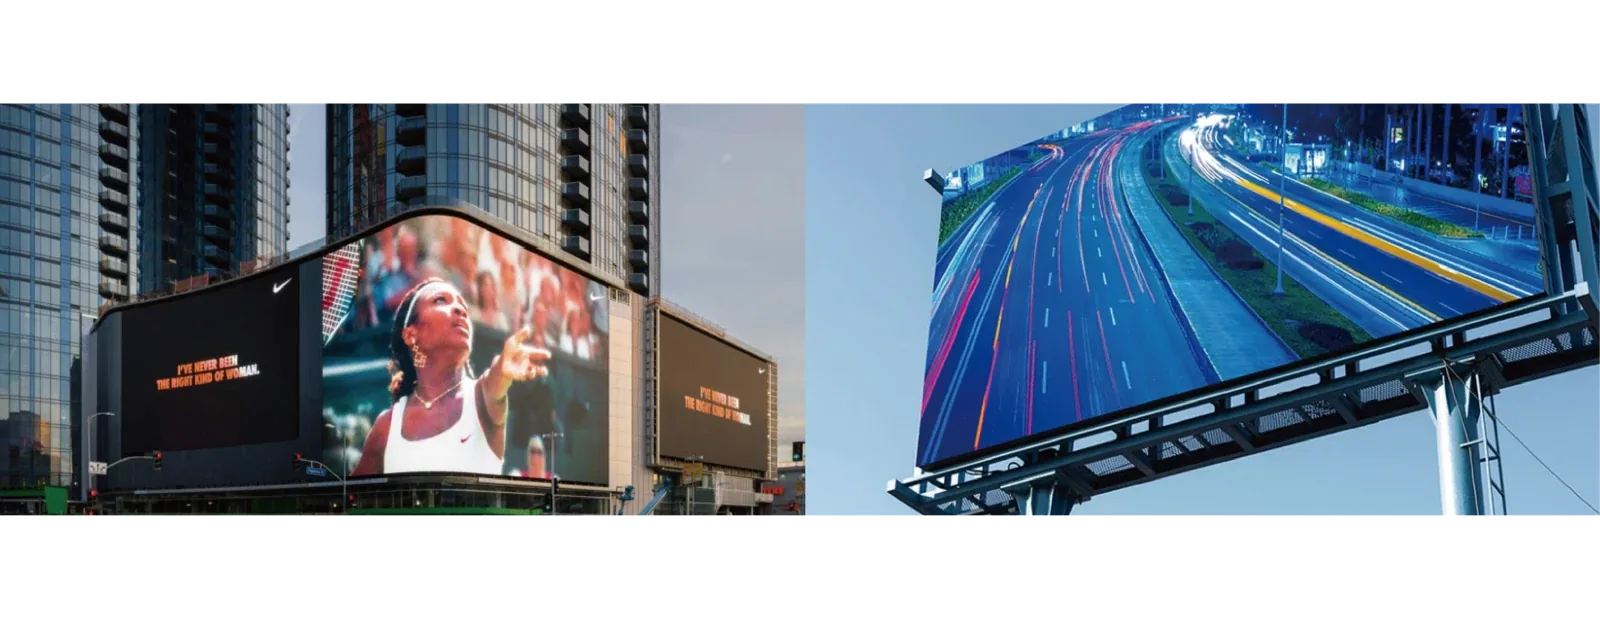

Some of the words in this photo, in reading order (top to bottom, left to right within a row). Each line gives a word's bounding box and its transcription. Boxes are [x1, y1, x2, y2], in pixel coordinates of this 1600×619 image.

[177, 364, 193, 375] I'VE
[194, 359, 218, 373] NEVER
[219, 354, 238, 368] BEEN
[156, 379, 170, 390] THE
[171, 375, 193, 388] RIGHT
[194, 373, 213, 385] KIND
[214, 371, 225, 382] OF
[226, 364, 260, 379] WOMAN.
